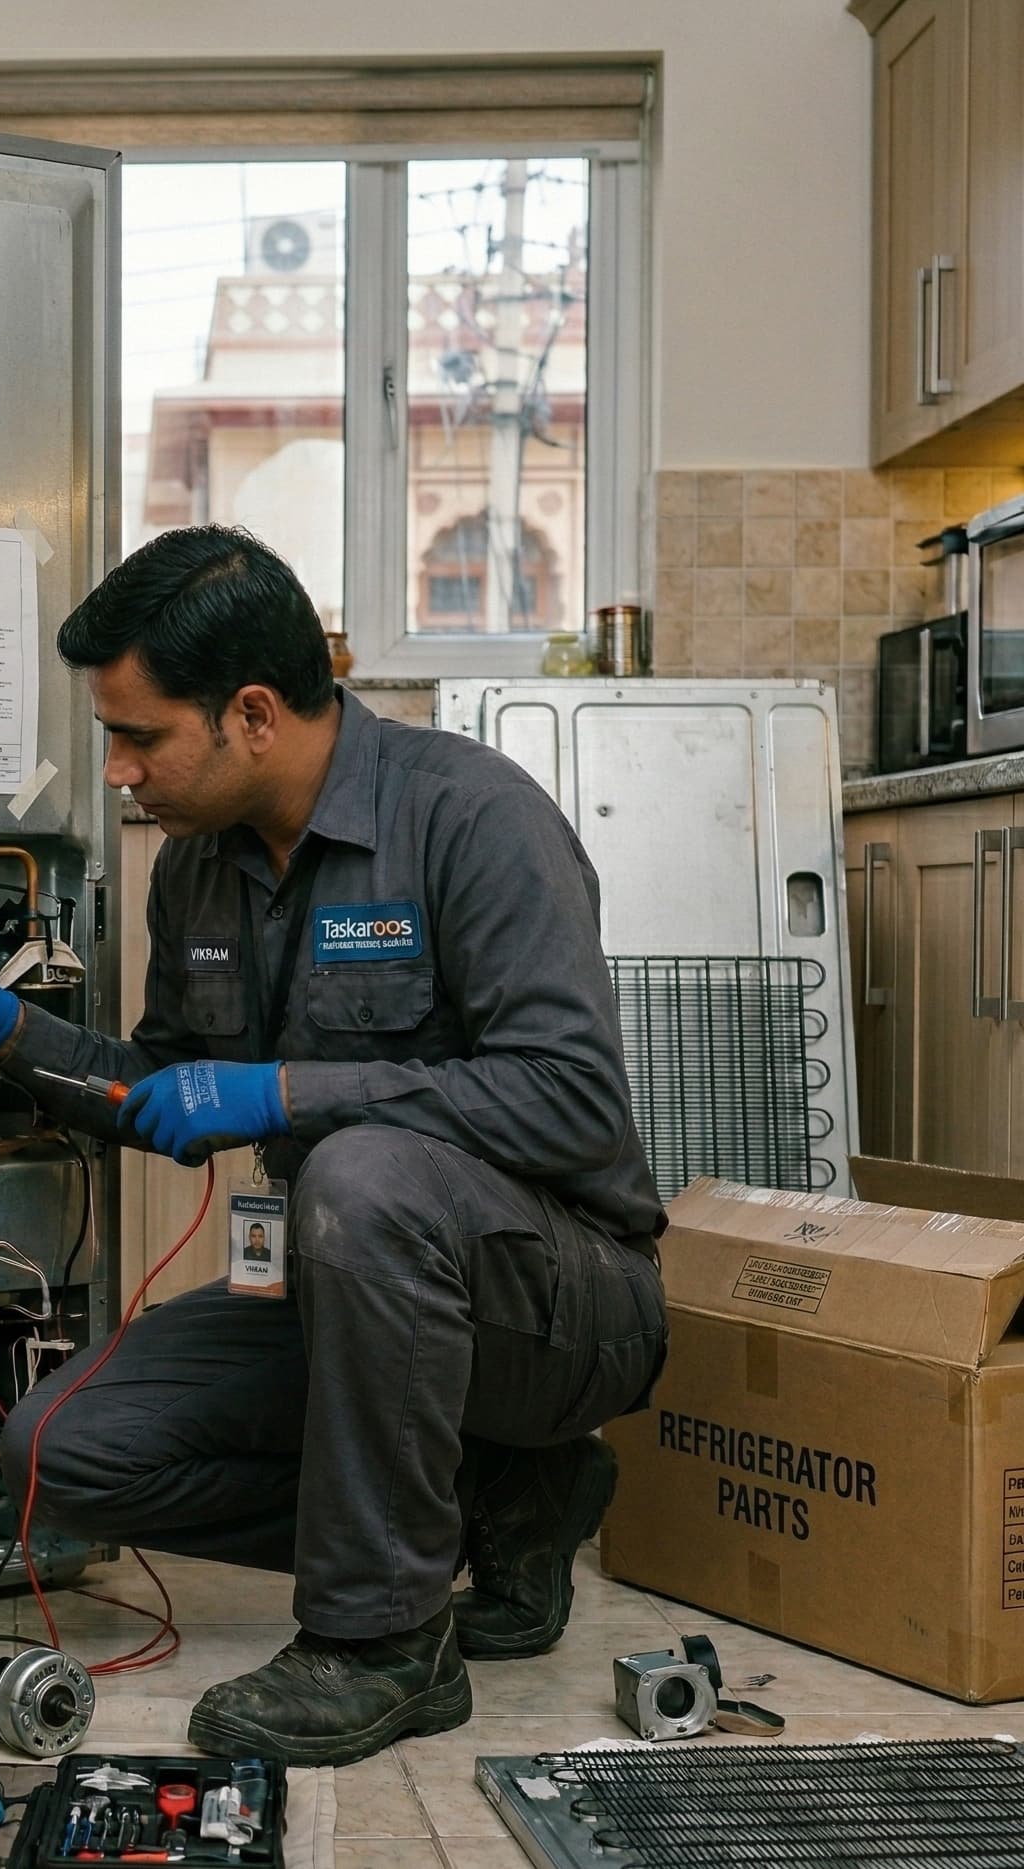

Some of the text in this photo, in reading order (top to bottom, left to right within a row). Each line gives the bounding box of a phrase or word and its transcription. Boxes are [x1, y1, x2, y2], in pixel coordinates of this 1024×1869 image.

[321, 917, 413, 939] Taskaroos
[190, 947, 229, 961] VIKRAM
[659, 1409, 876, 1506] REFRIGERATOR
[717, 1476, 810, 1541] PARTS
